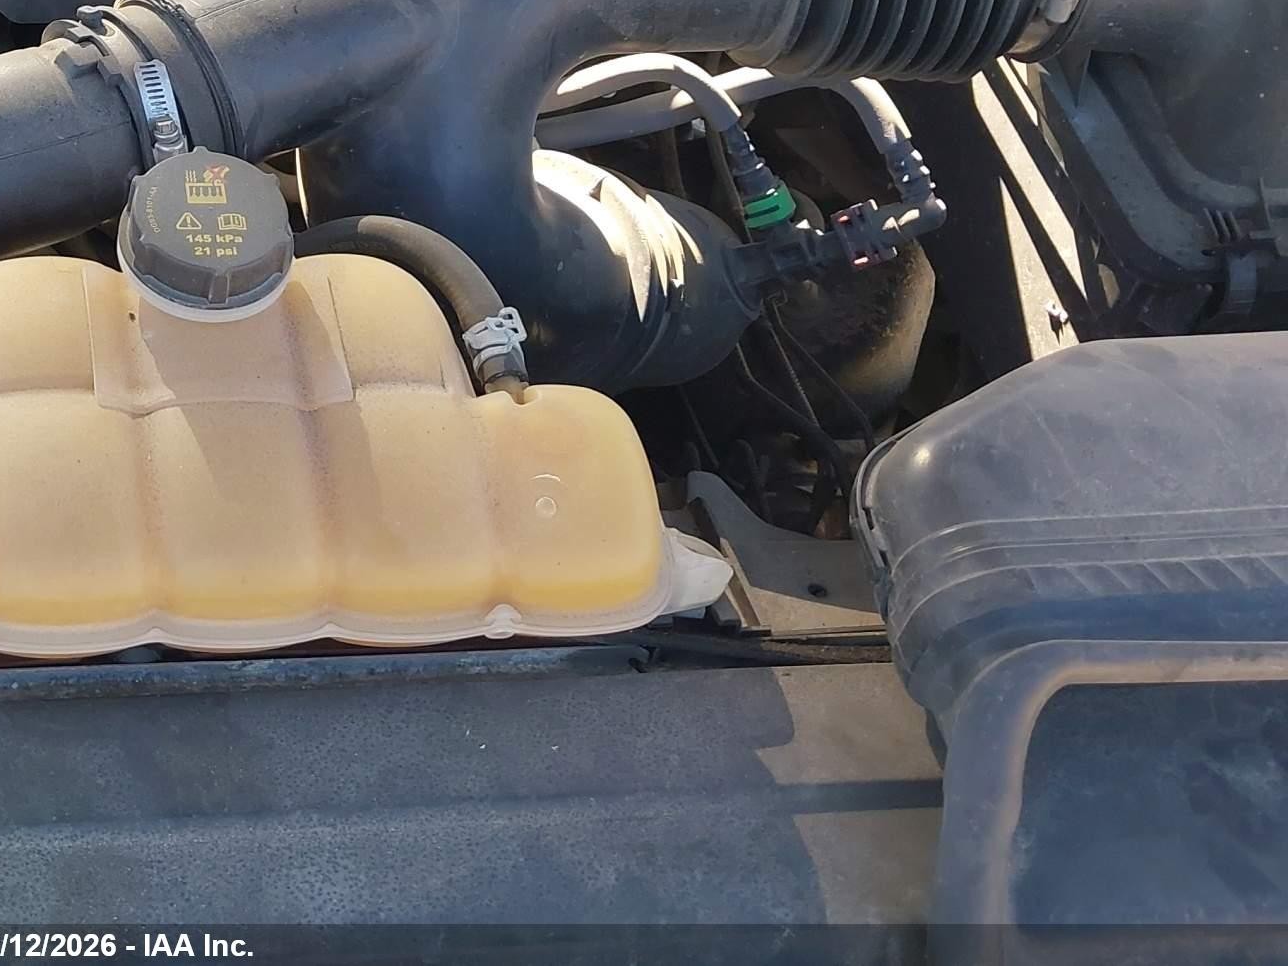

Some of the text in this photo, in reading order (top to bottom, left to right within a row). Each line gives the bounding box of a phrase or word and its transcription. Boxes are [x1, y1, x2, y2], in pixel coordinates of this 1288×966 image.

[186, 234, 243, 243] 145 kPa
[194, 246, 238, 257] 21 psi
